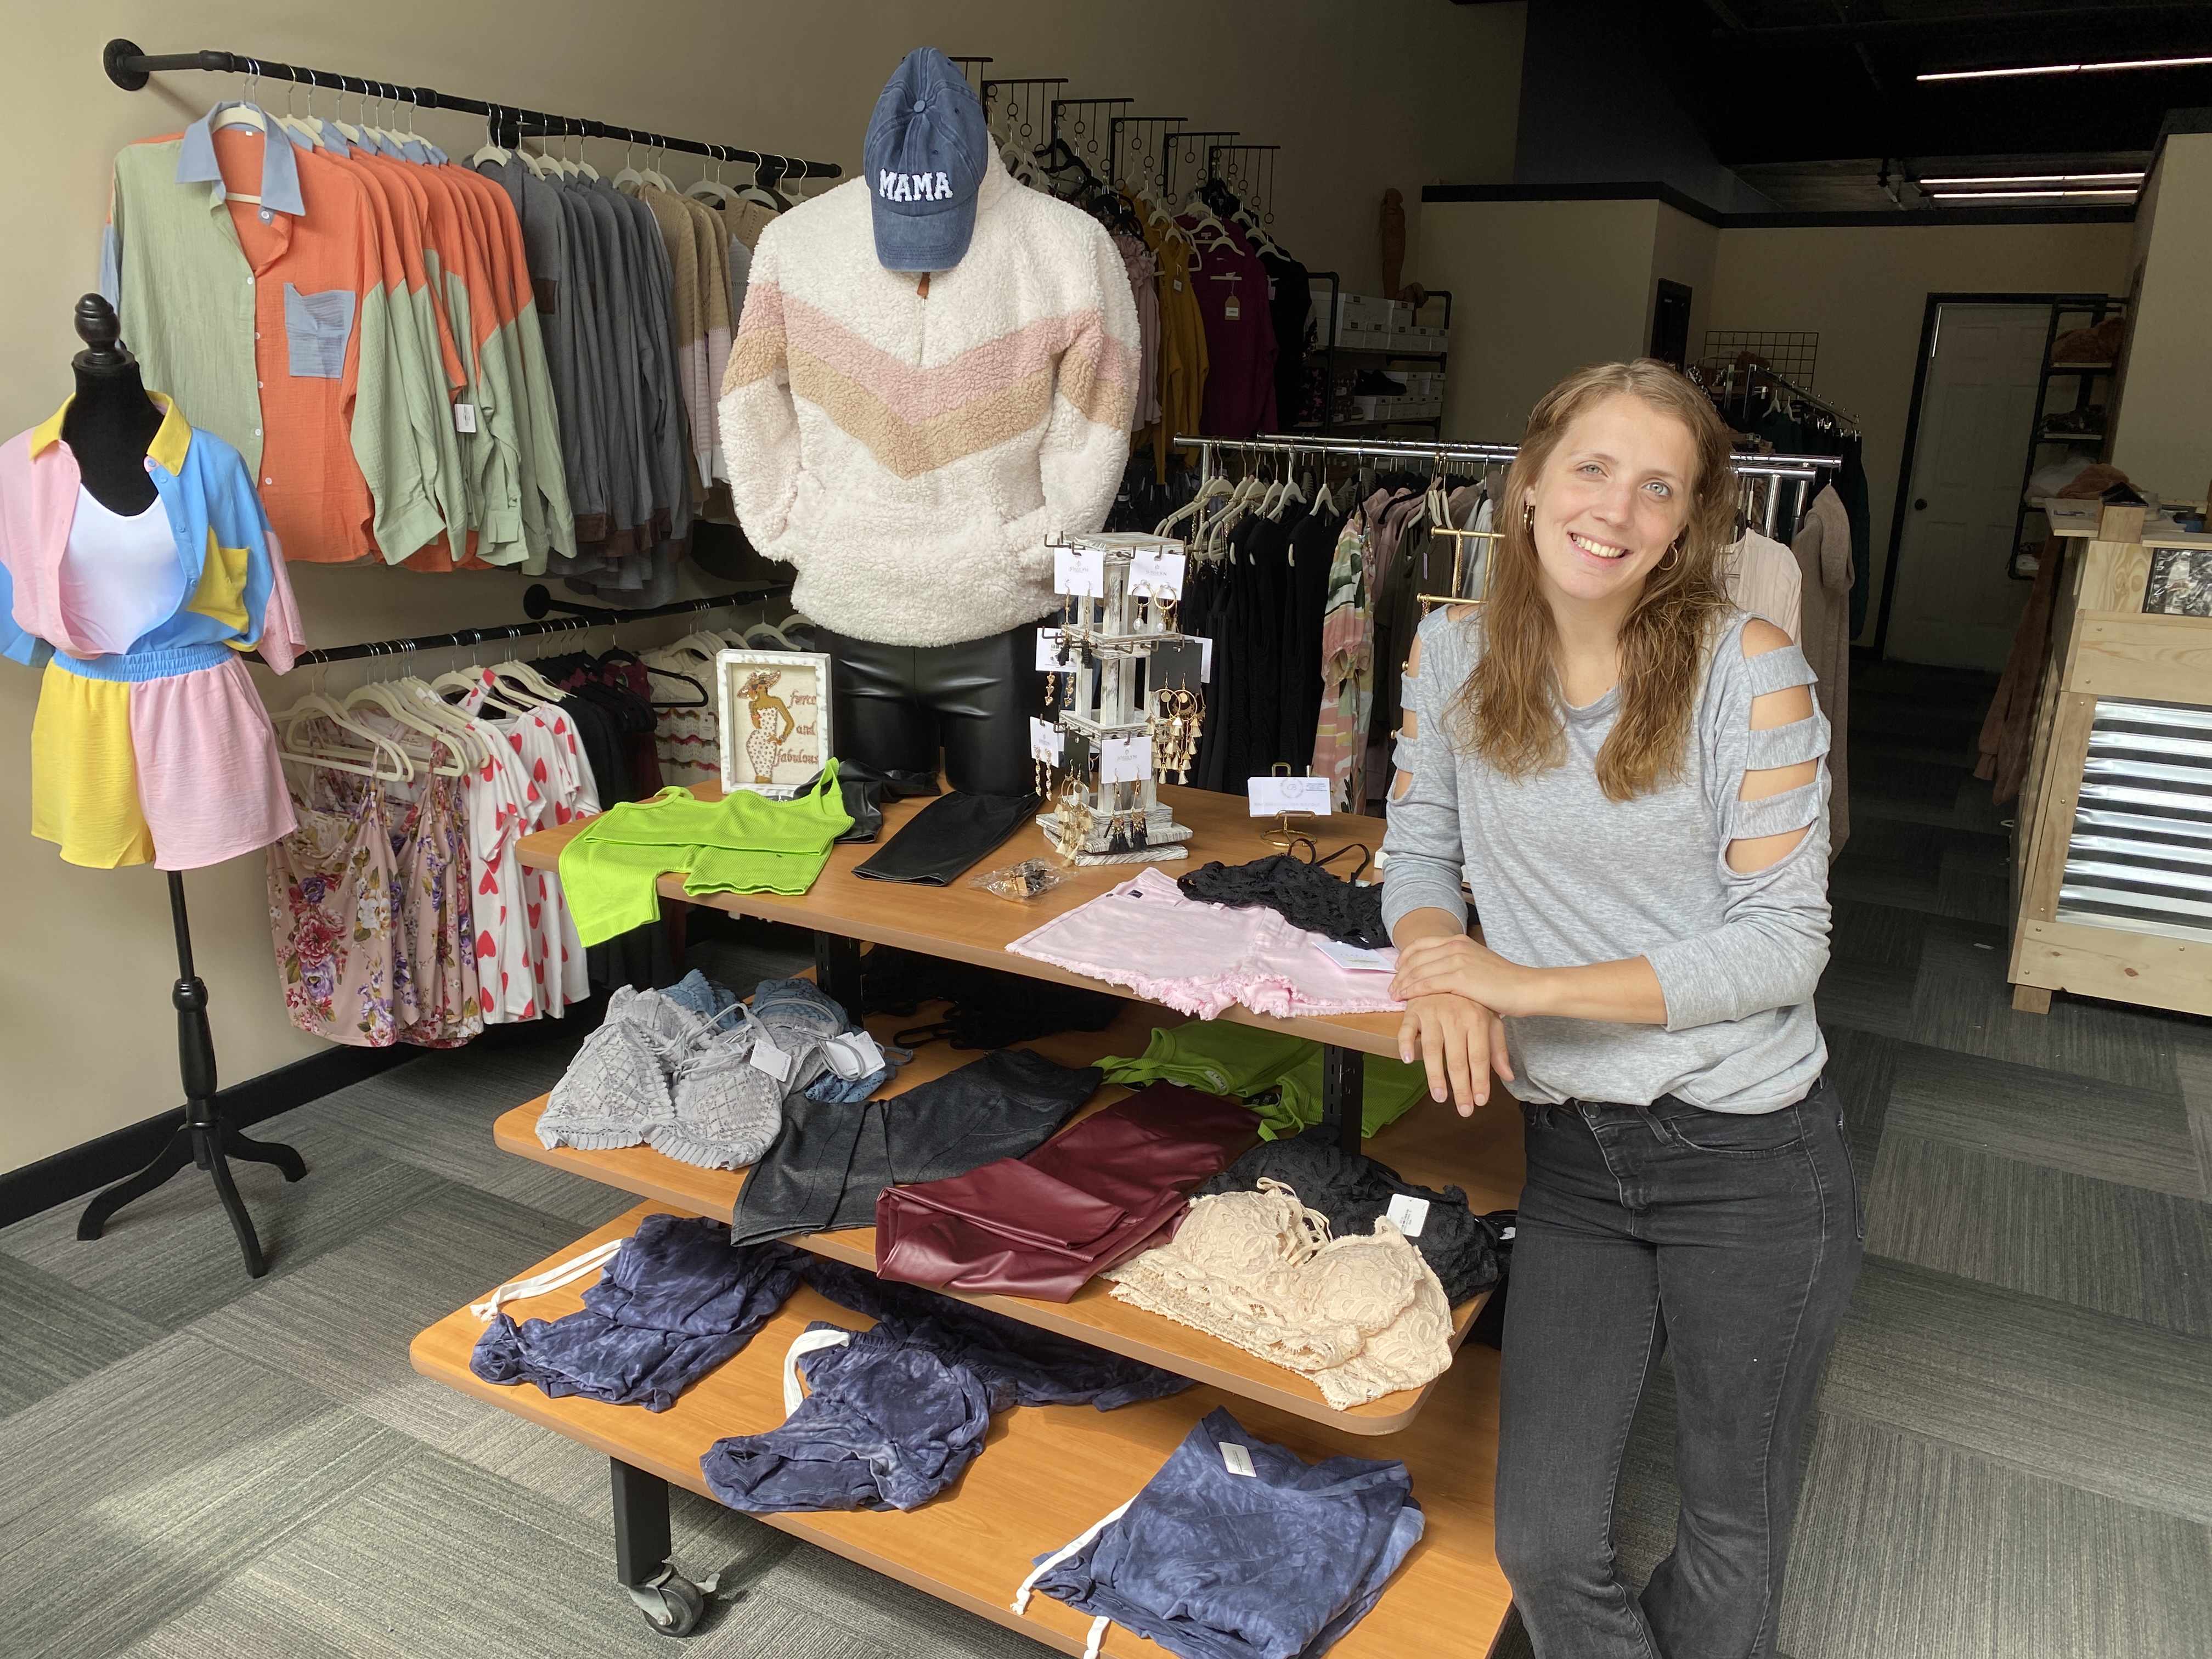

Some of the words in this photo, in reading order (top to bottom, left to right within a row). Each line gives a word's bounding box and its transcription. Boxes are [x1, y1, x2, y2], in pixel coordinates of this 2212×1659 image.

[879, 168, 953, 202] MAMA
[796, 720, 816, 735] and
[774, 748, 819, 767] fabulous
